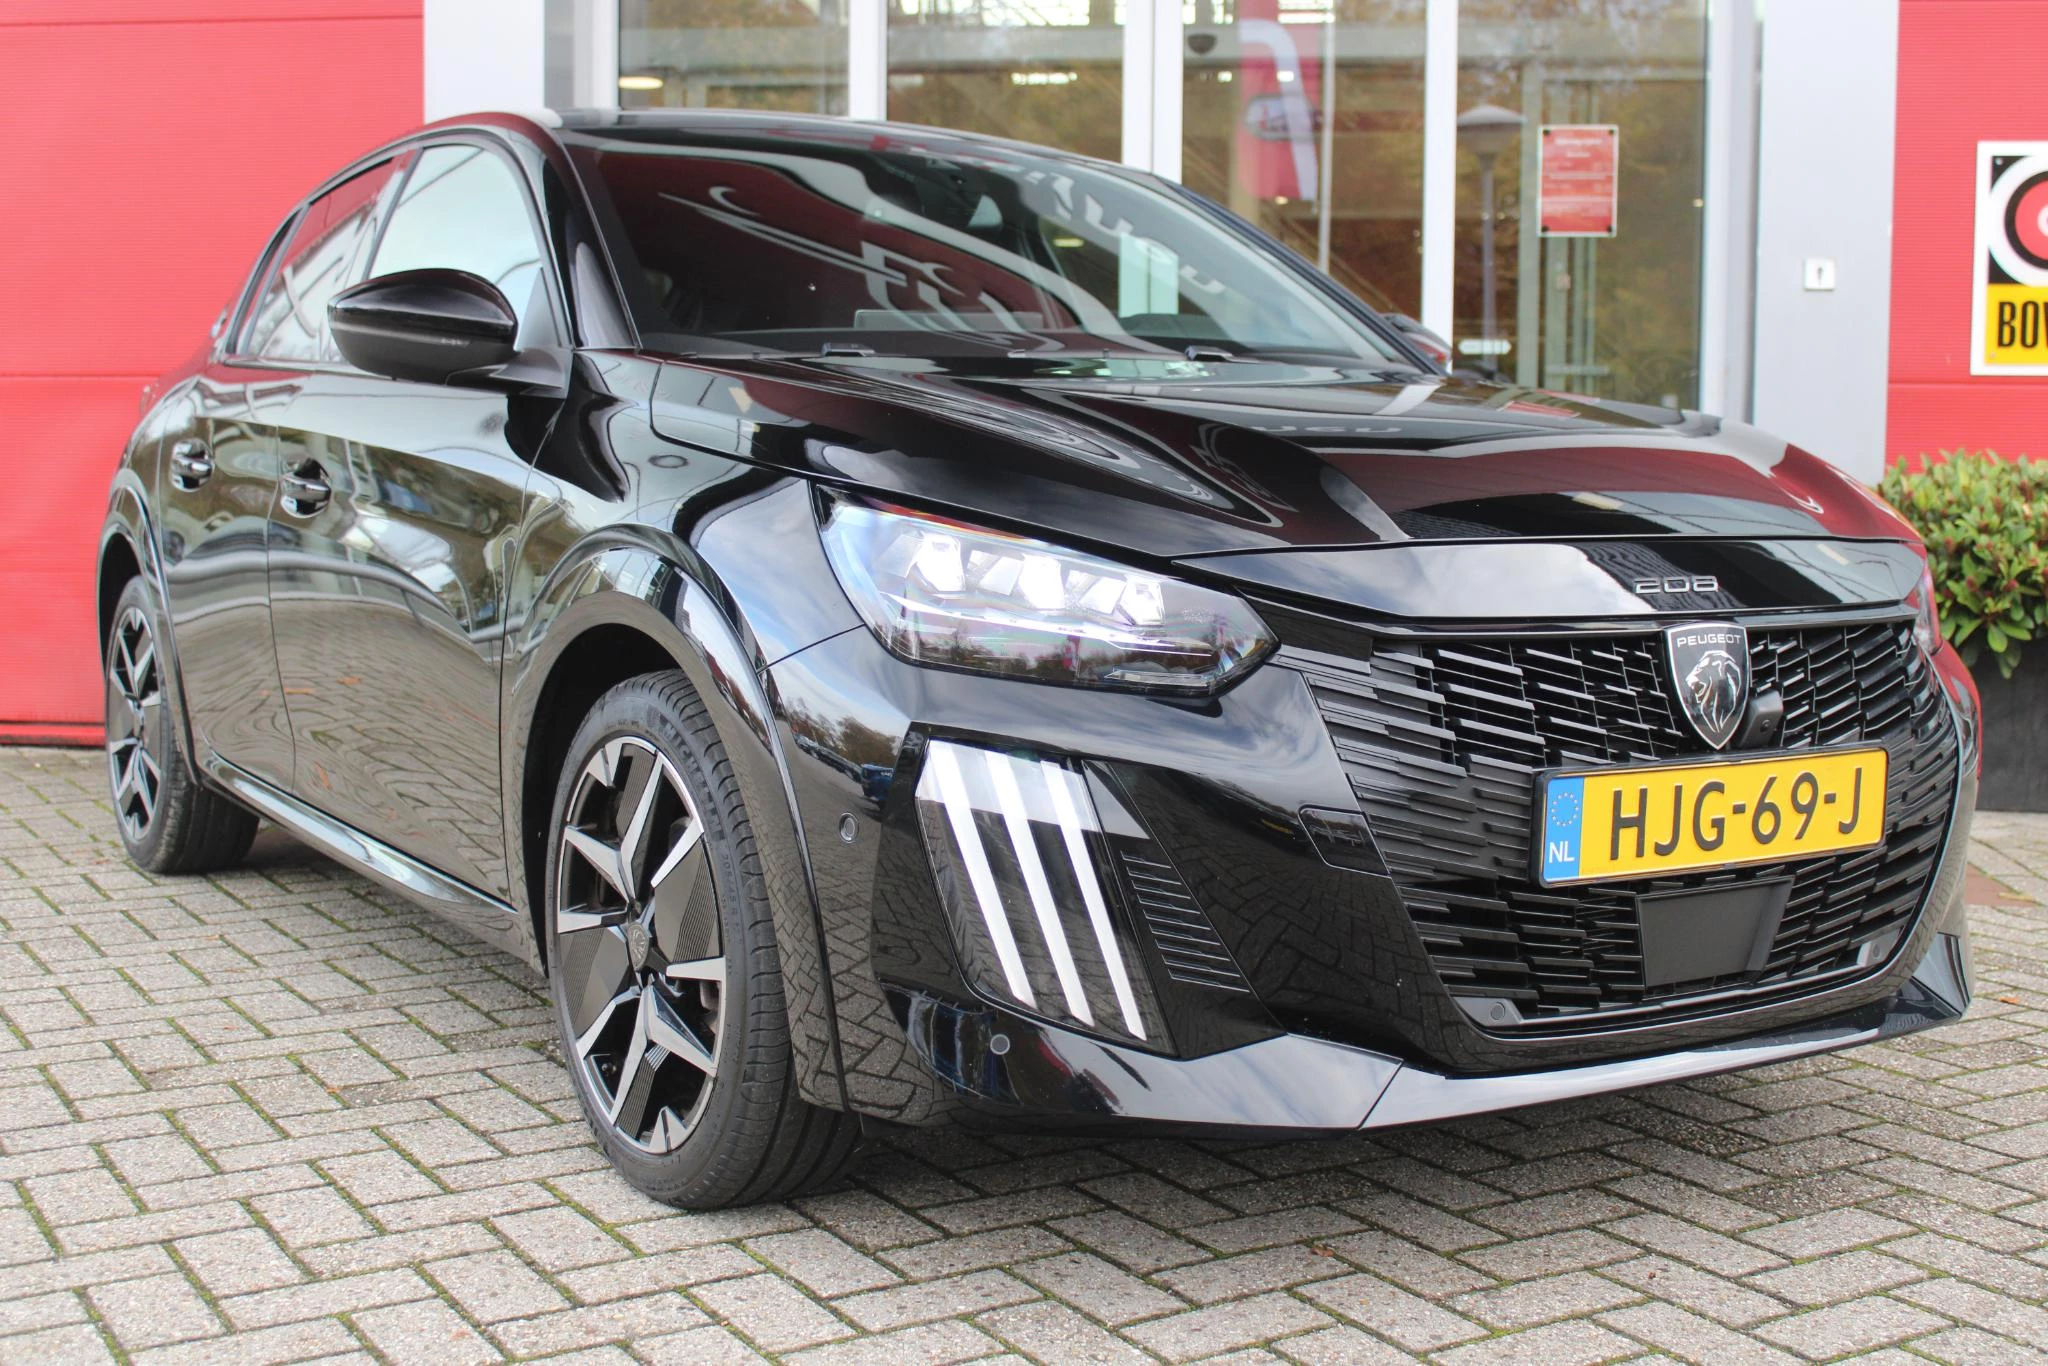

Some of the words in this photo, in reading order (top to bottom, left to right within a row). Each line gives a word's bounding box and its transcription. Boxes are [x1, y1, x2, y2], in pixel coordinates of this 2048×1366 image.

[1997, 301, 2048, 349] BO
[1633, 576, 1719, 594] 208
[1676, 634, 1741, 648] PEUGEOT
[663, 720, 723, 837] MICHELIN
[1609, 766, 1863, 861] HJG-69-J
[1549, 840, 1575, 864] NL
